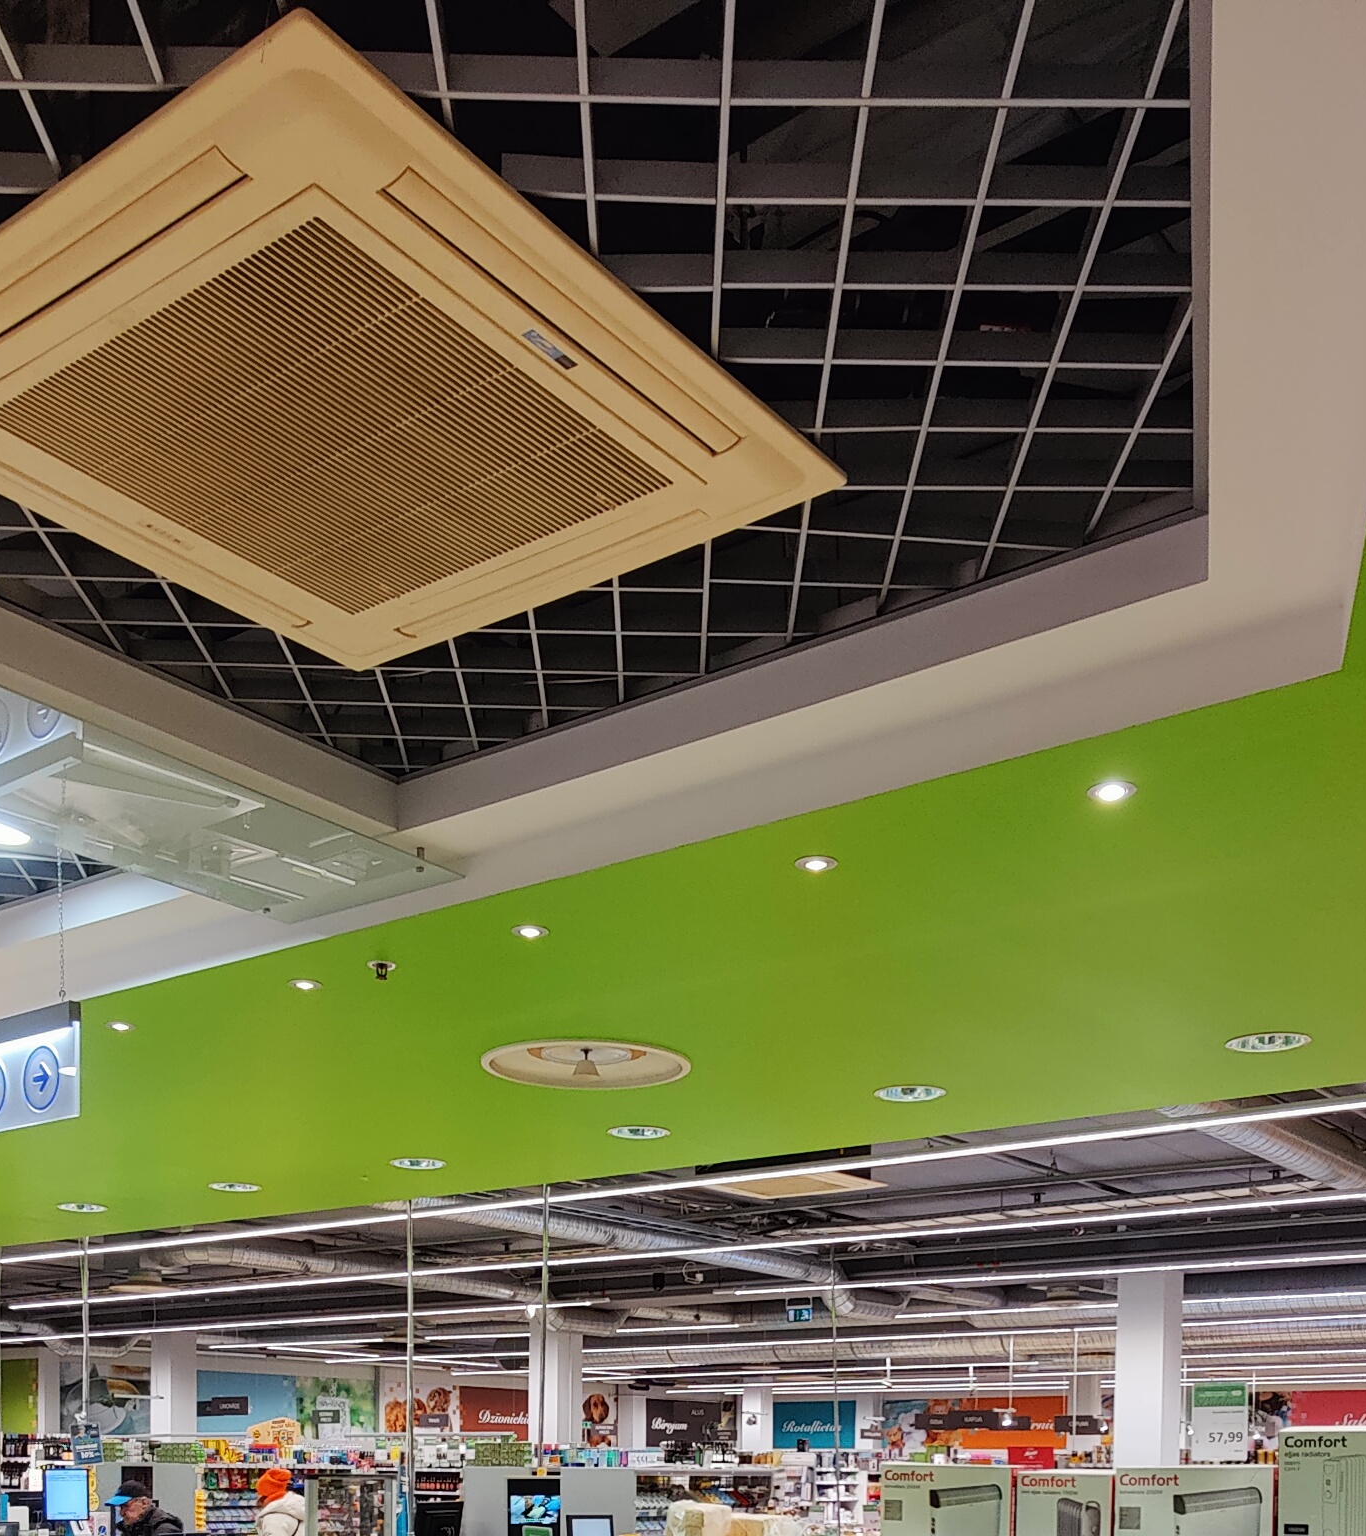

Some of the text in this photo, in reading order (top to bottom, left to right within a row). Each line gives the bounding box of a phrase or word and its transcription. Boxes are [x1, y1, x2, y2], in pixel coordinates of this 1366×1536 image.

[651, 1417, 688, 1434] Birojam
[1208, 1431, 1243, 1445] 57,99
[1284, 1436, 1348, 1448] Comfort
[1301, 1450, 1331, 1458] radiators
[884, 1470, 935, 1482] Comfort
[1021, 1475, 1076, 1488] Comfort
[1119, 1474, 1179, 1487] Comfort
